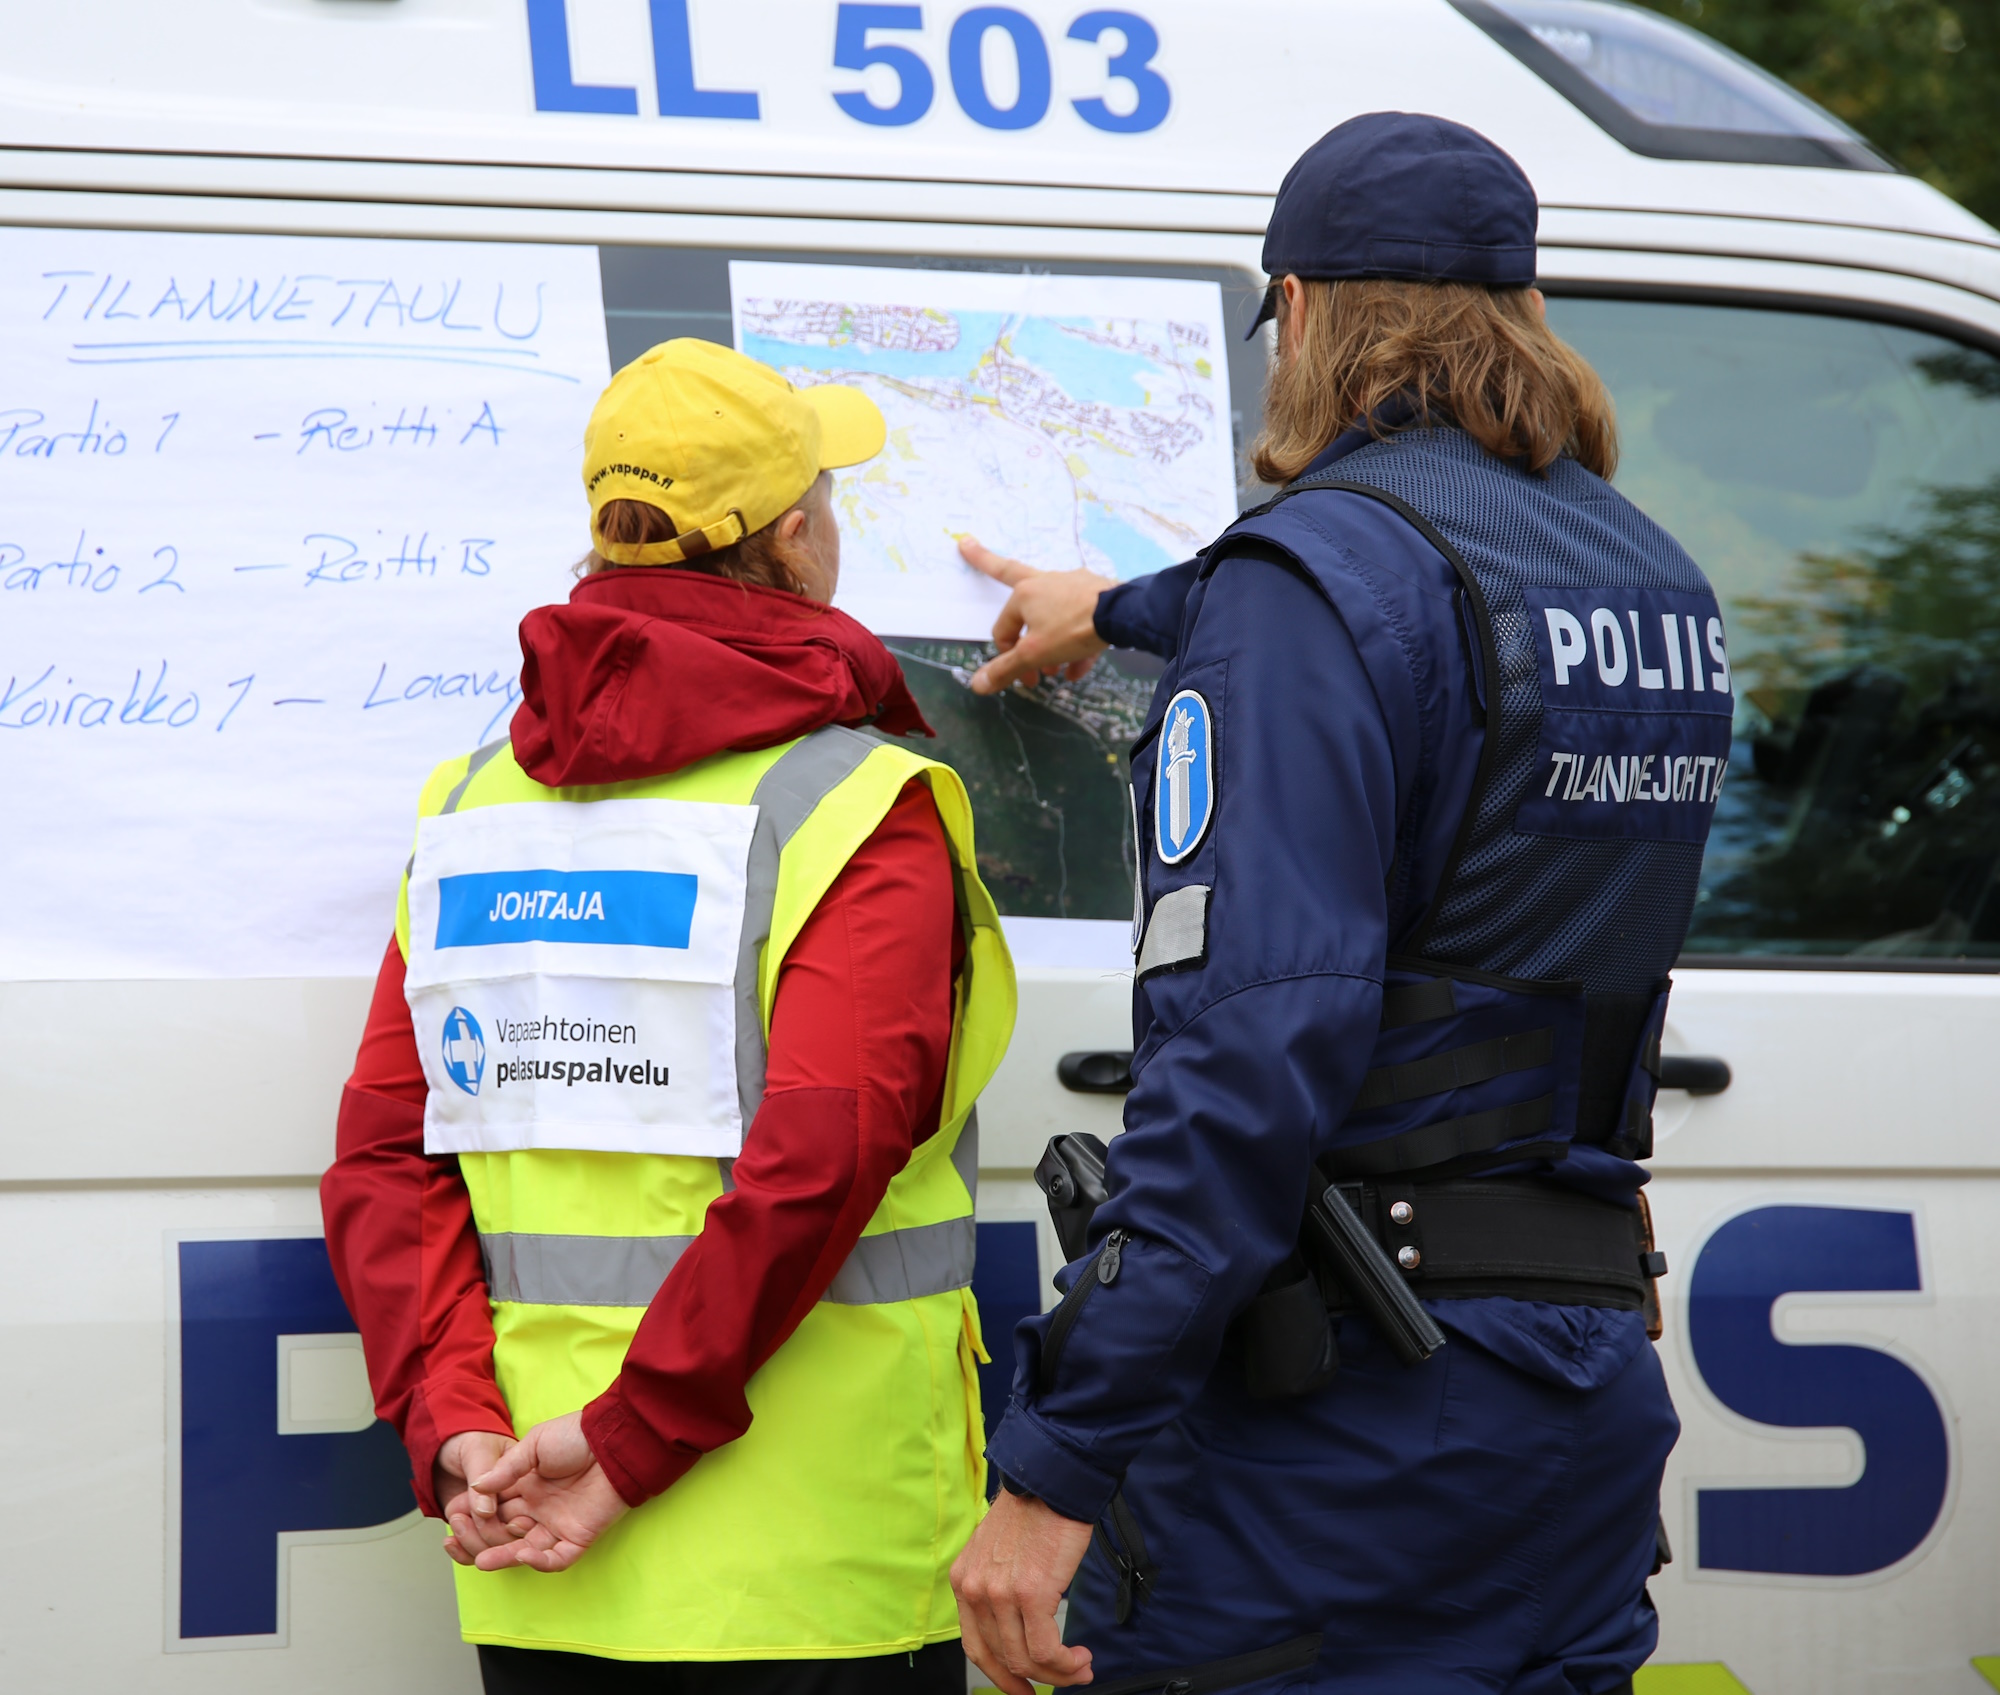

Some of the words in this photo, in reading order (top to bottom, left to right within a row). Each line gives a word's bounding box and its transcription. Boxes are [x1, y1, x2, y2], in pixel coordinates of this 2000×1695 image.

[526, 0, 760, 120] LL
[832, 3, 1172, 133] 503
[42, 271, 547, 340] TILANNETAULU
[0, 398, 128, 458] Partio
[154, 411, 180, 453] 1
[296, 401, 452, 454] Reitti
[459, 400, 506, 446] A
[589, 463, 675, 491] www.vapepa.fi
[0, 529, 121, 593] Partio
[137, 545, 185, 593] 2
[303, 530, 446, 587] Reitti
[459, 538, 497, 576] B
[1543, 607, 1732, 694] POLIIS
[0, 658, 200, 729] Koirakko
[216, 673, 255, 732] 1
[489, 890, 605, 922] JOHTAJA
[496, 1014, 637, 1048] Vapaaehtoinen
[497, 1055, 670, 1089] pelasuspalvelu
